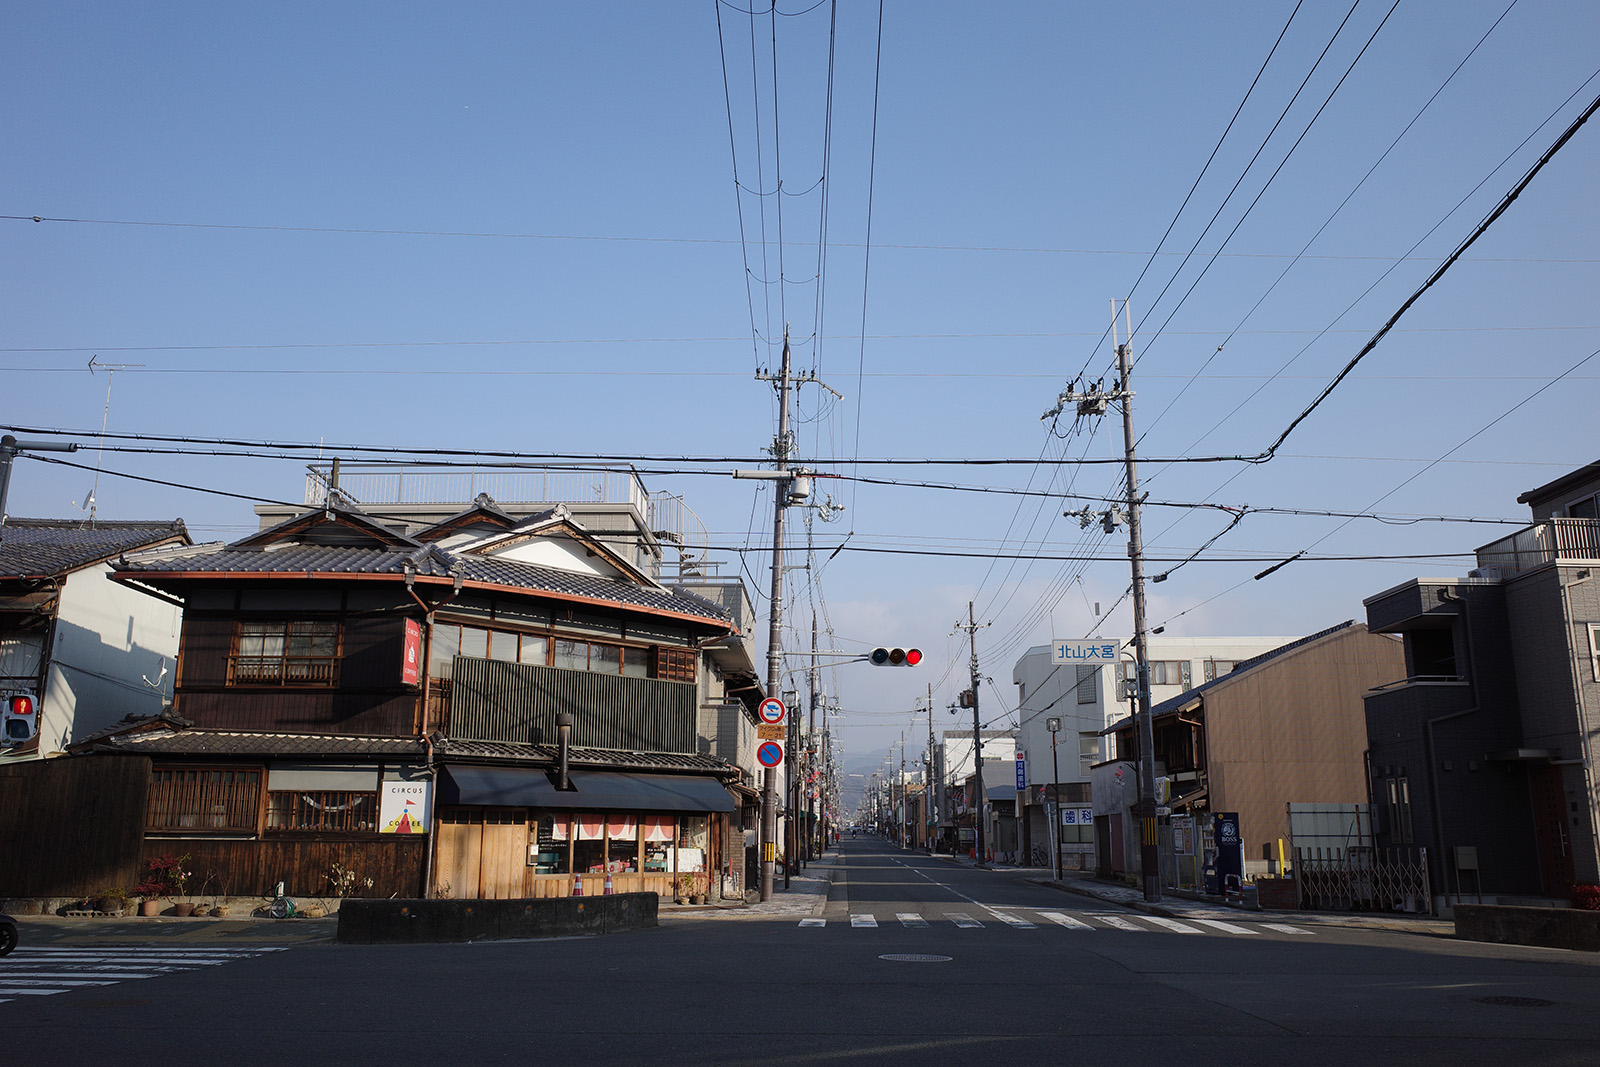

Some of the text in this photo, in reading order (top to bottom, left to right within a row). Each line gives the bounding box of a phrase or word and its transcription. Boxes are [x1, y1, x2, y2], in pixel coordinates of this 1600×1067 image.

[1058, 645, 1115, 658] 北山大宮
[1065, 810, 1092, 823] 歯科
